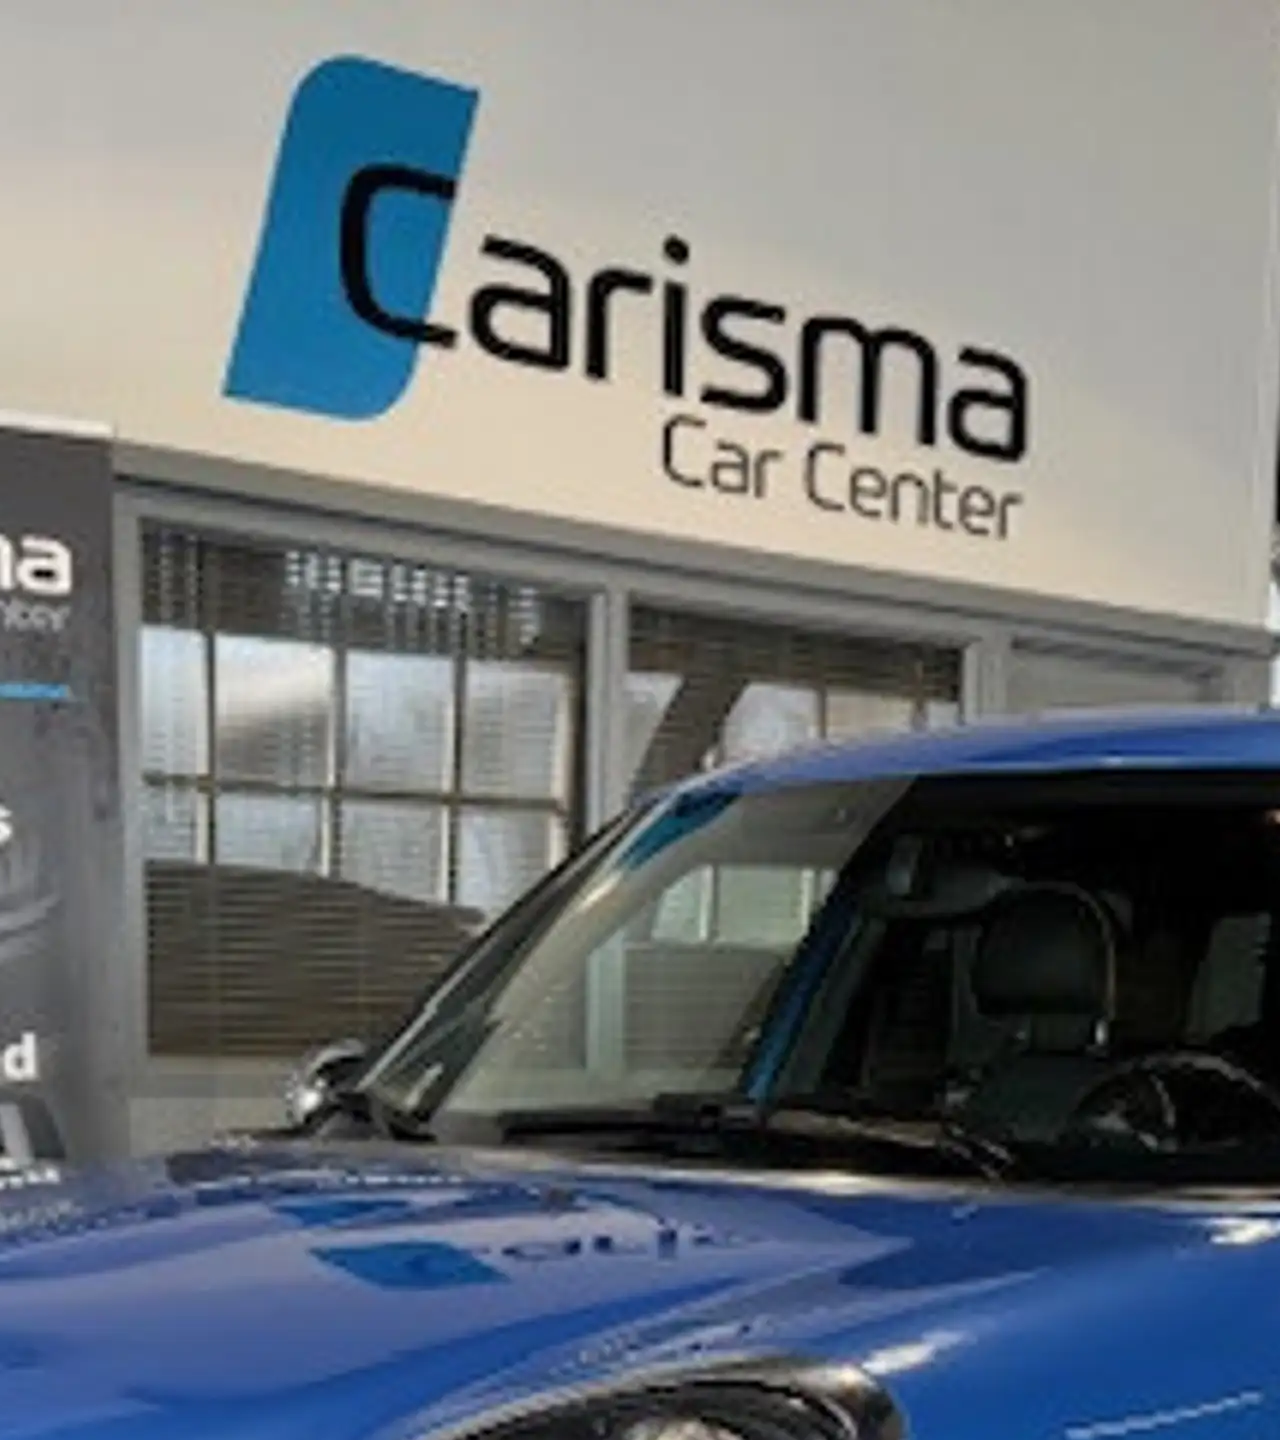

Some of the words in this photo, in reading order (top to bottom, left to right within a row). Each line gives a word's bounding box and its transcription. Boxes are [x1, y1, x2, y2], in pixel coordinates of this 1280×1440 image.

[339, 163, 1029, 464] Carisma
[663, 414, 783, 499] Car
[802, 443, 1024, 541] Center
